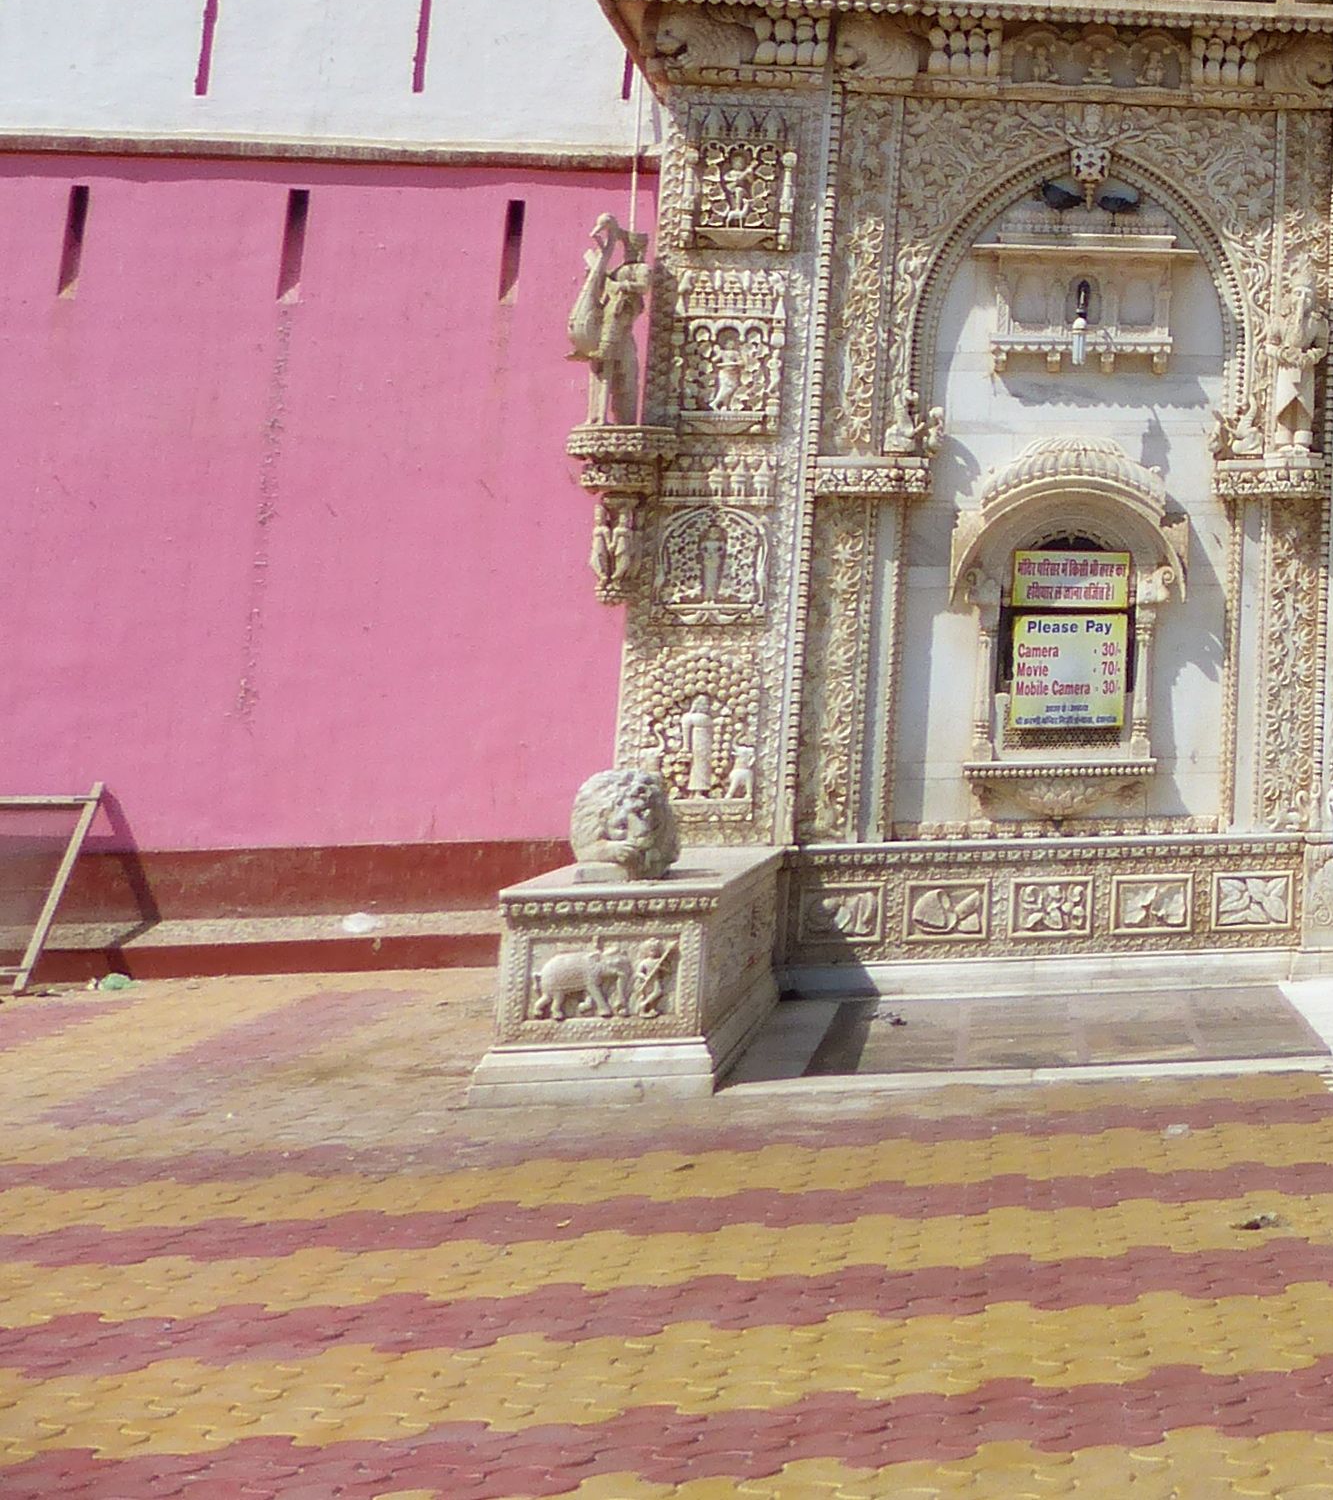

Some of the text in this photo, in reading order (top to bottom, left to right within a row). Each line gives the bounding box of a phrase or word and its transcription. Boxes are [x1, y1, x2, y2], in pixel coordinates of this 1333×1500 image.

[1027, 620, 1112, 635] Please Pay
[1018, 643, 1059, 658] Camera
[1016, 662, 1048, 677] Movie
[1016, 681, 1049, 696] Mobile
[1052, 680, 1091, 695] Camera
